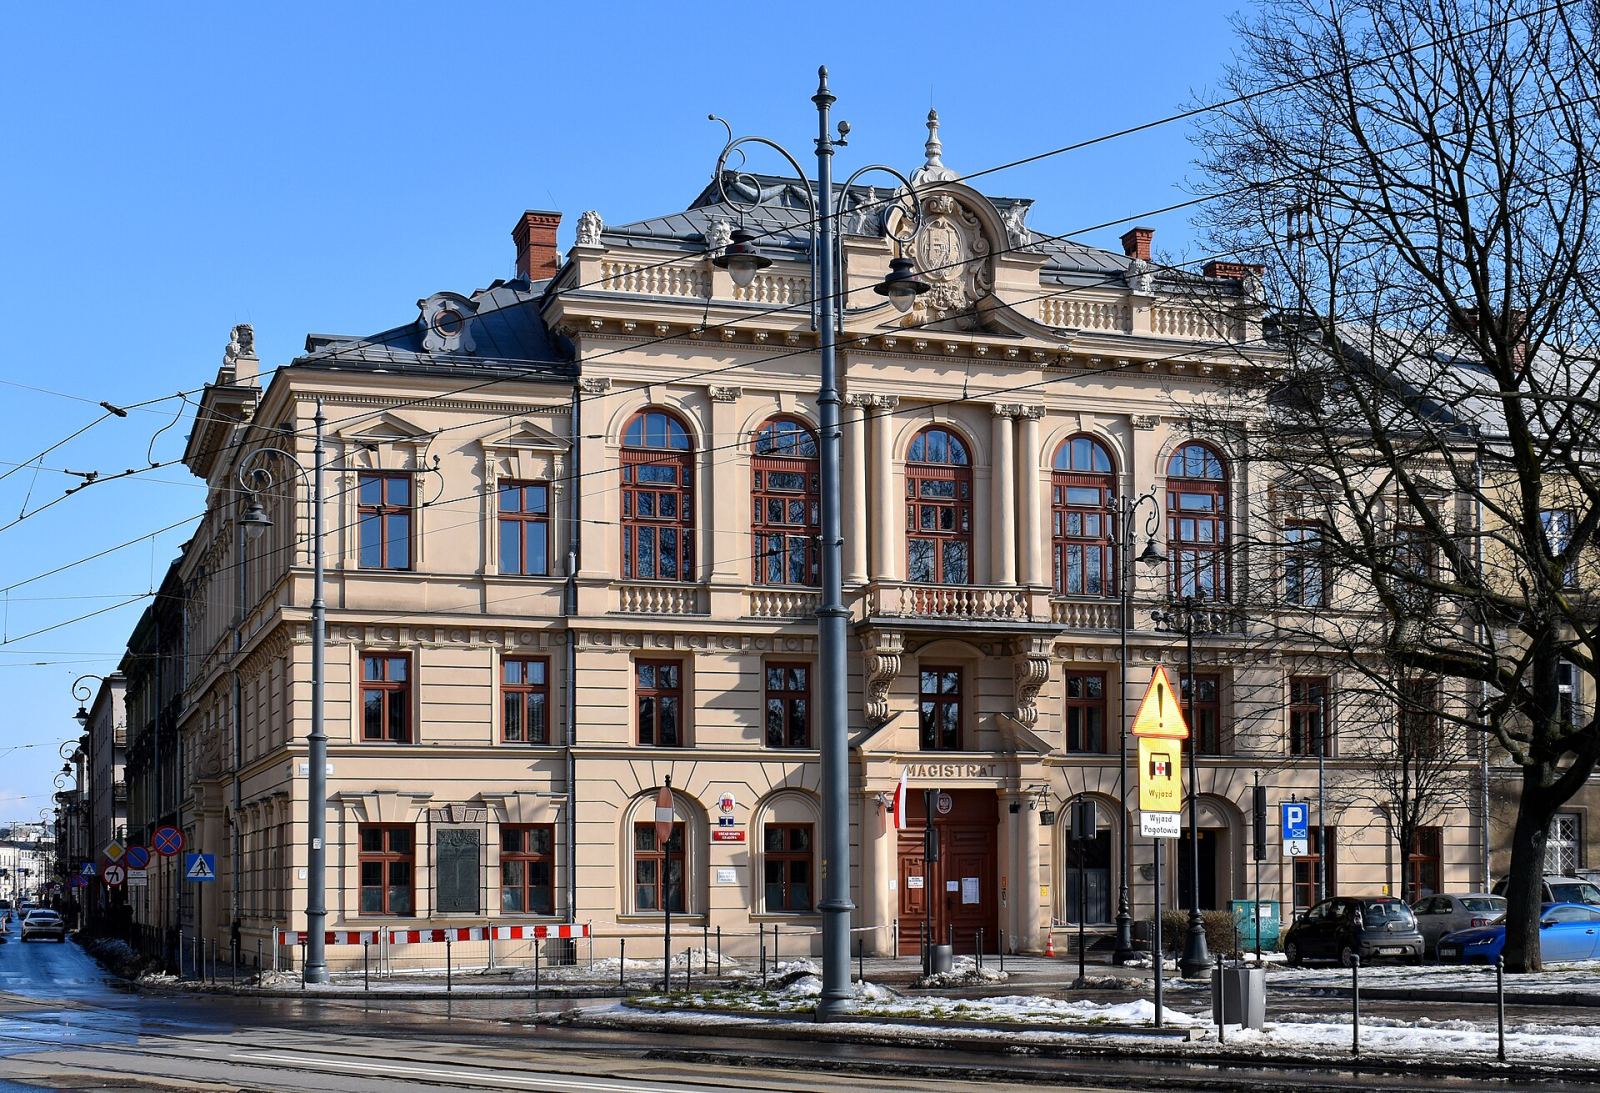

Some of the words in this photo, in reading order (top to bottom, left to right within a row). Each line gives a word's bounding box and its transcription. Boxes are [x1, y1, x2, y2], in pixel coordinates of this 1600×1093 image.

[907, 764, 996, 777] MAGISTRAT
[1149, 789, 1173, 799] Wyjazd
[1150, 814, 1173, 824] Wyjazd
[1287, 806, 1303, 829] P
[1144, 825, 1178, 835] Pogotowia
